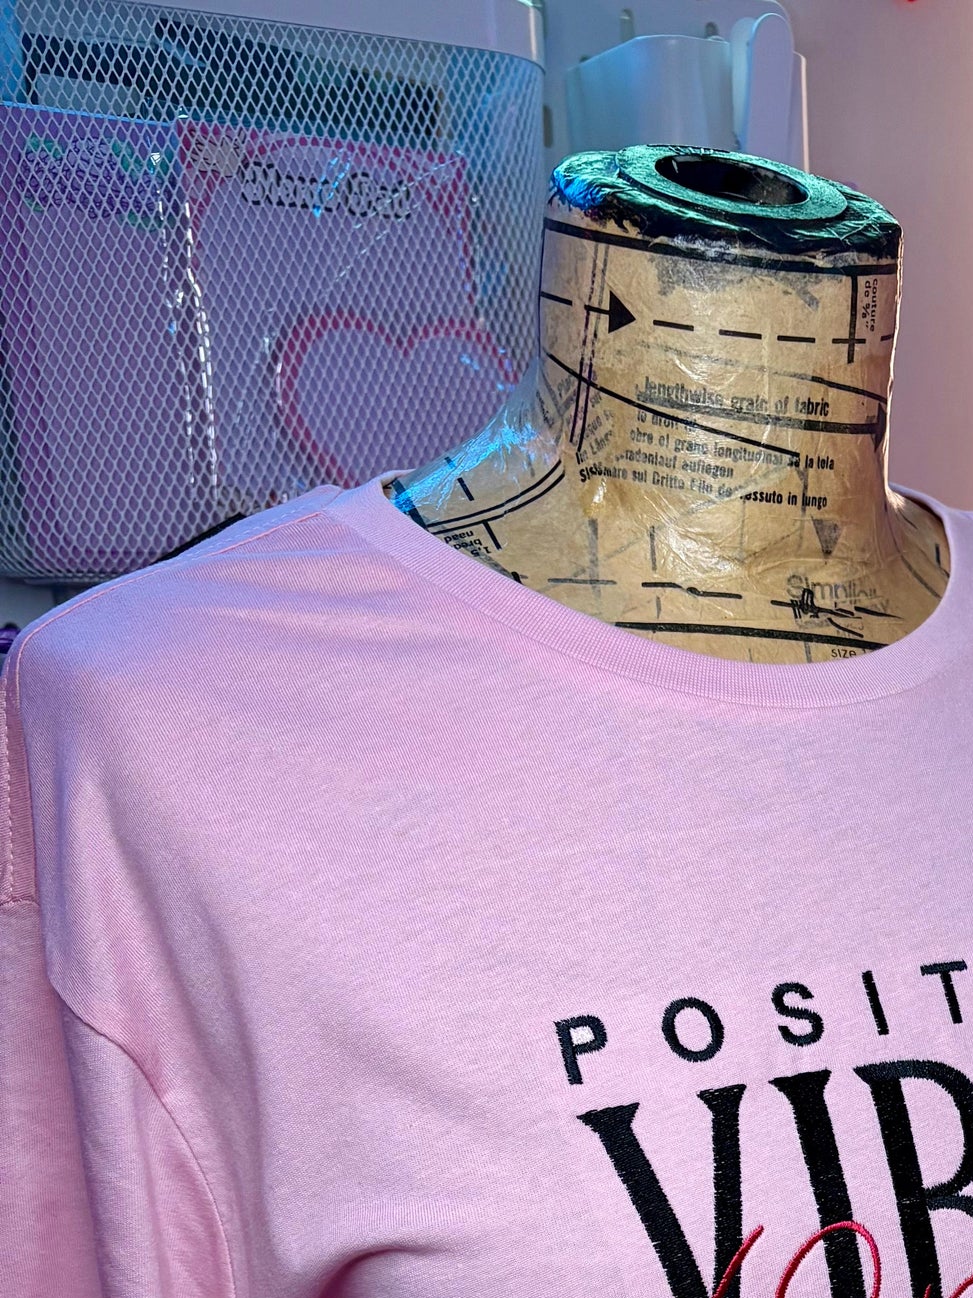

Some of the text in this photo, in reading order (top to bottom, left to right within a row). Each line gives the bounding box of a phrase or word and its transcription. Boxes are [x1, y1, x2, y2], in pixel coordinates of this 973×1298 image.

[864, 280, 871, 298] de
[869, 278, 878, 332] couture
[774, 396, 789, 414] of
[794, 397, 829, 417] fabric
[804, 455, 816, 469] la
[817, 456, 835, 470] tela
[741, 490, 783, 504] essuto
[787, 491, 798, 505] in
[802, 493, 828, 510] lungo
[444, 530, 474, 544] naad
